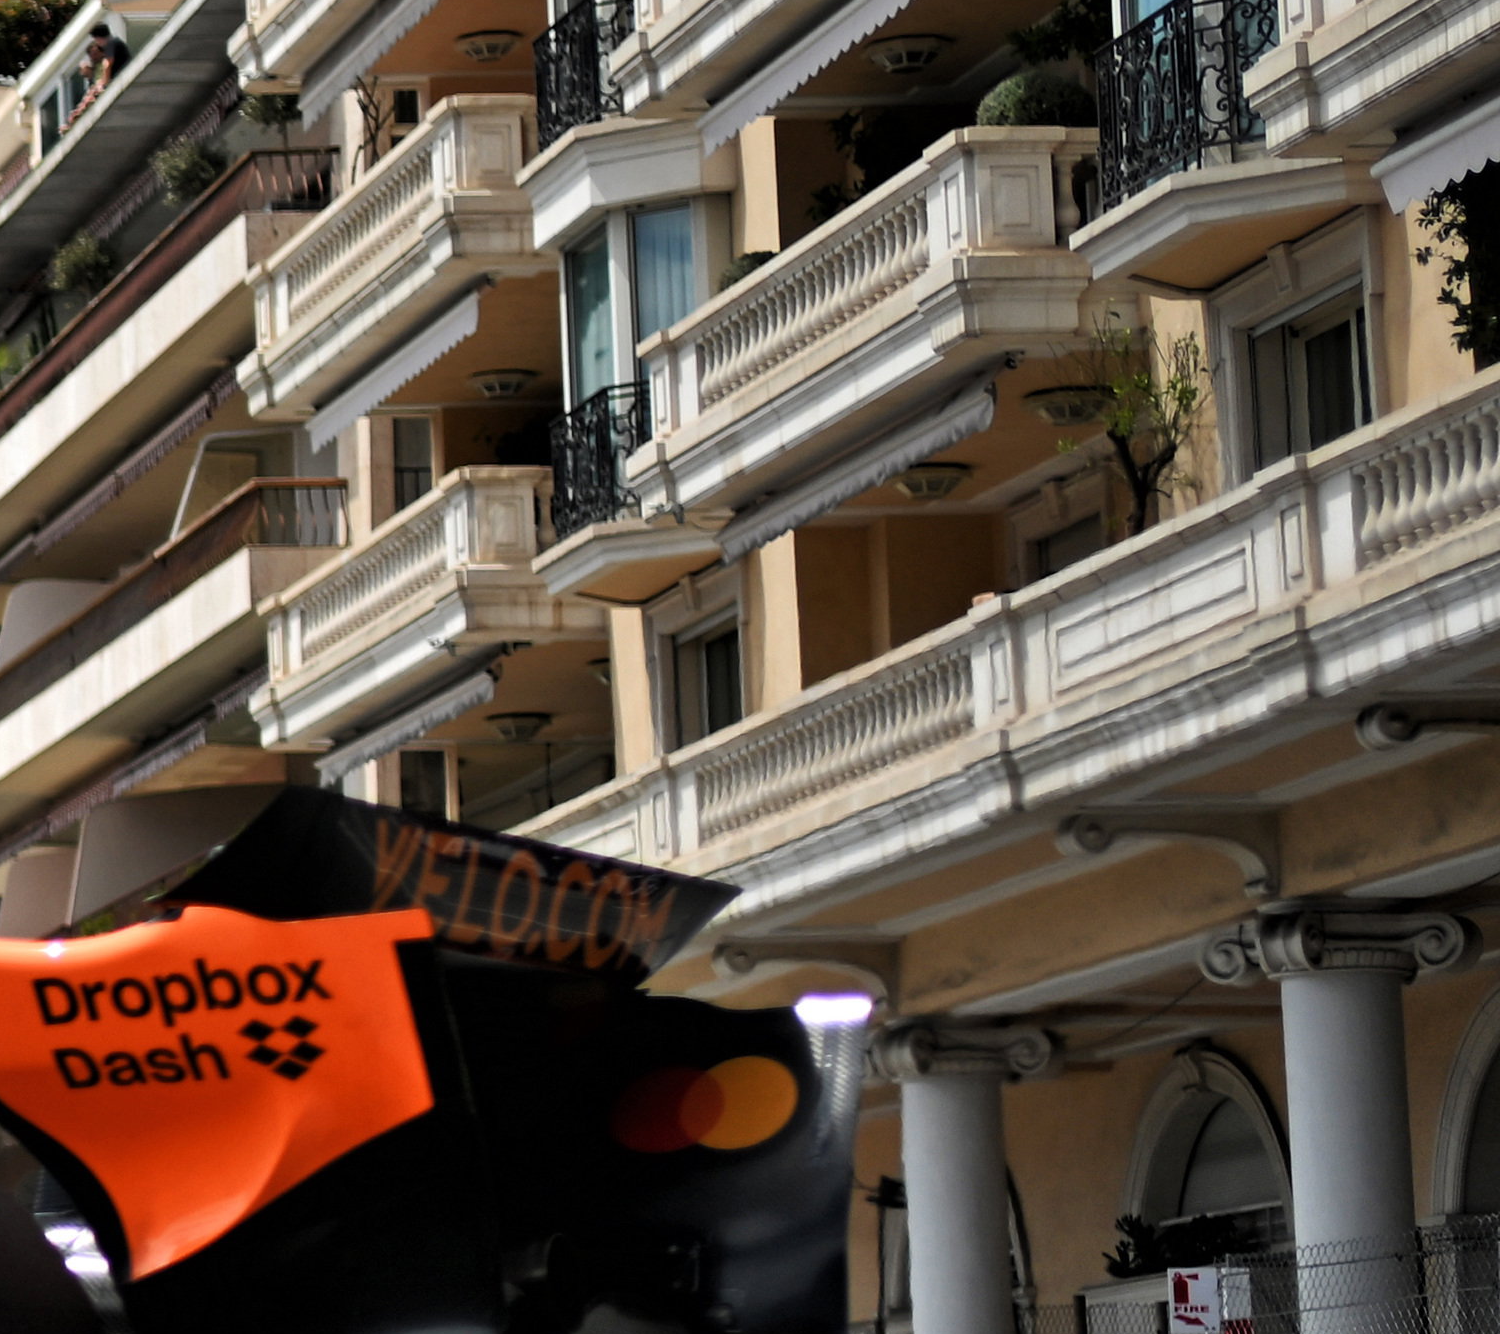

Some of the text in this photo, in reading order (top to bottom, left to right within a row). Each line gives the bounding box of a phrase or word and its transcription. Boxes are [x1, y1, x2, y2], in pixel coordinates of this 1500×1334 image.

[31, 958, 333, 1027] Dropbox
[52, 1032, 231, 1089] Dash
[1175, 1305, 1209, 1313] FIRE
